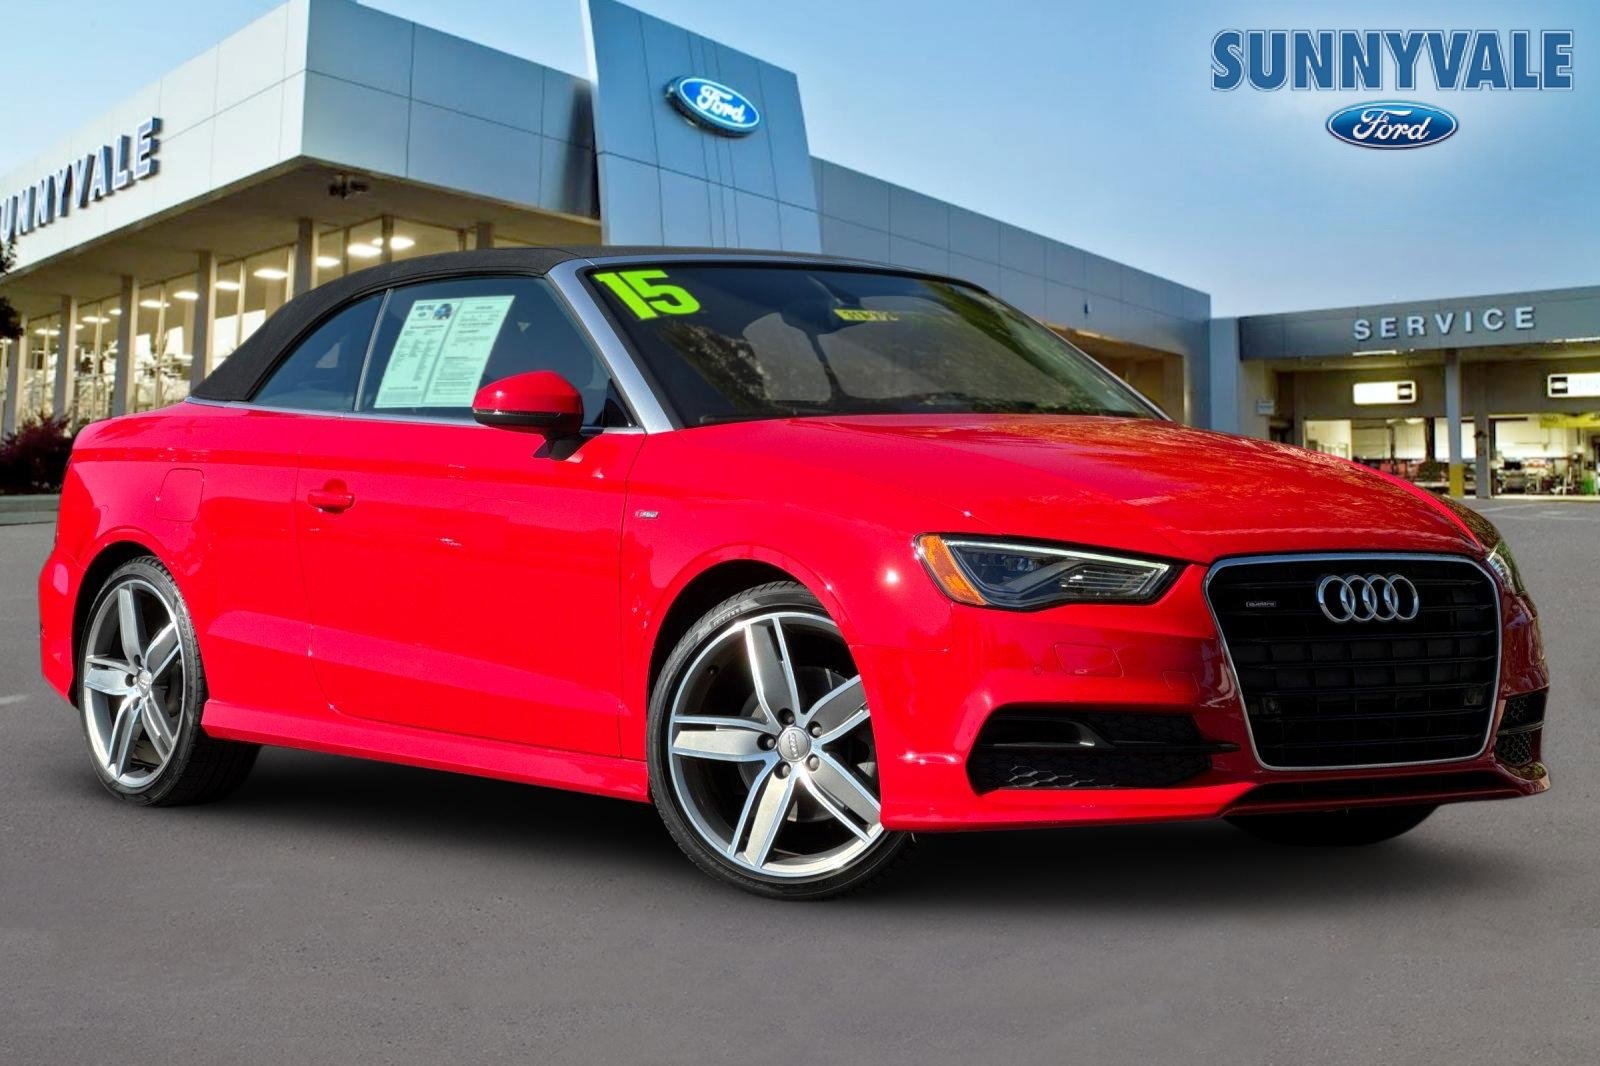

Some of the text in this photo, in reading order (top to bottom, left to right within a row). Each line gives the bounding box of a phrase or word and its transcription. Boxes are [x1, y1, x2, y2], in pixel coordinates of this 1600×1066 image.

[696, 84, 746, 122] Ford
[0, 117, 162, 242] UNNYVALE
[593, 270, 700, 320] 15
[1353, 301, 1535, 341] SERVICE
